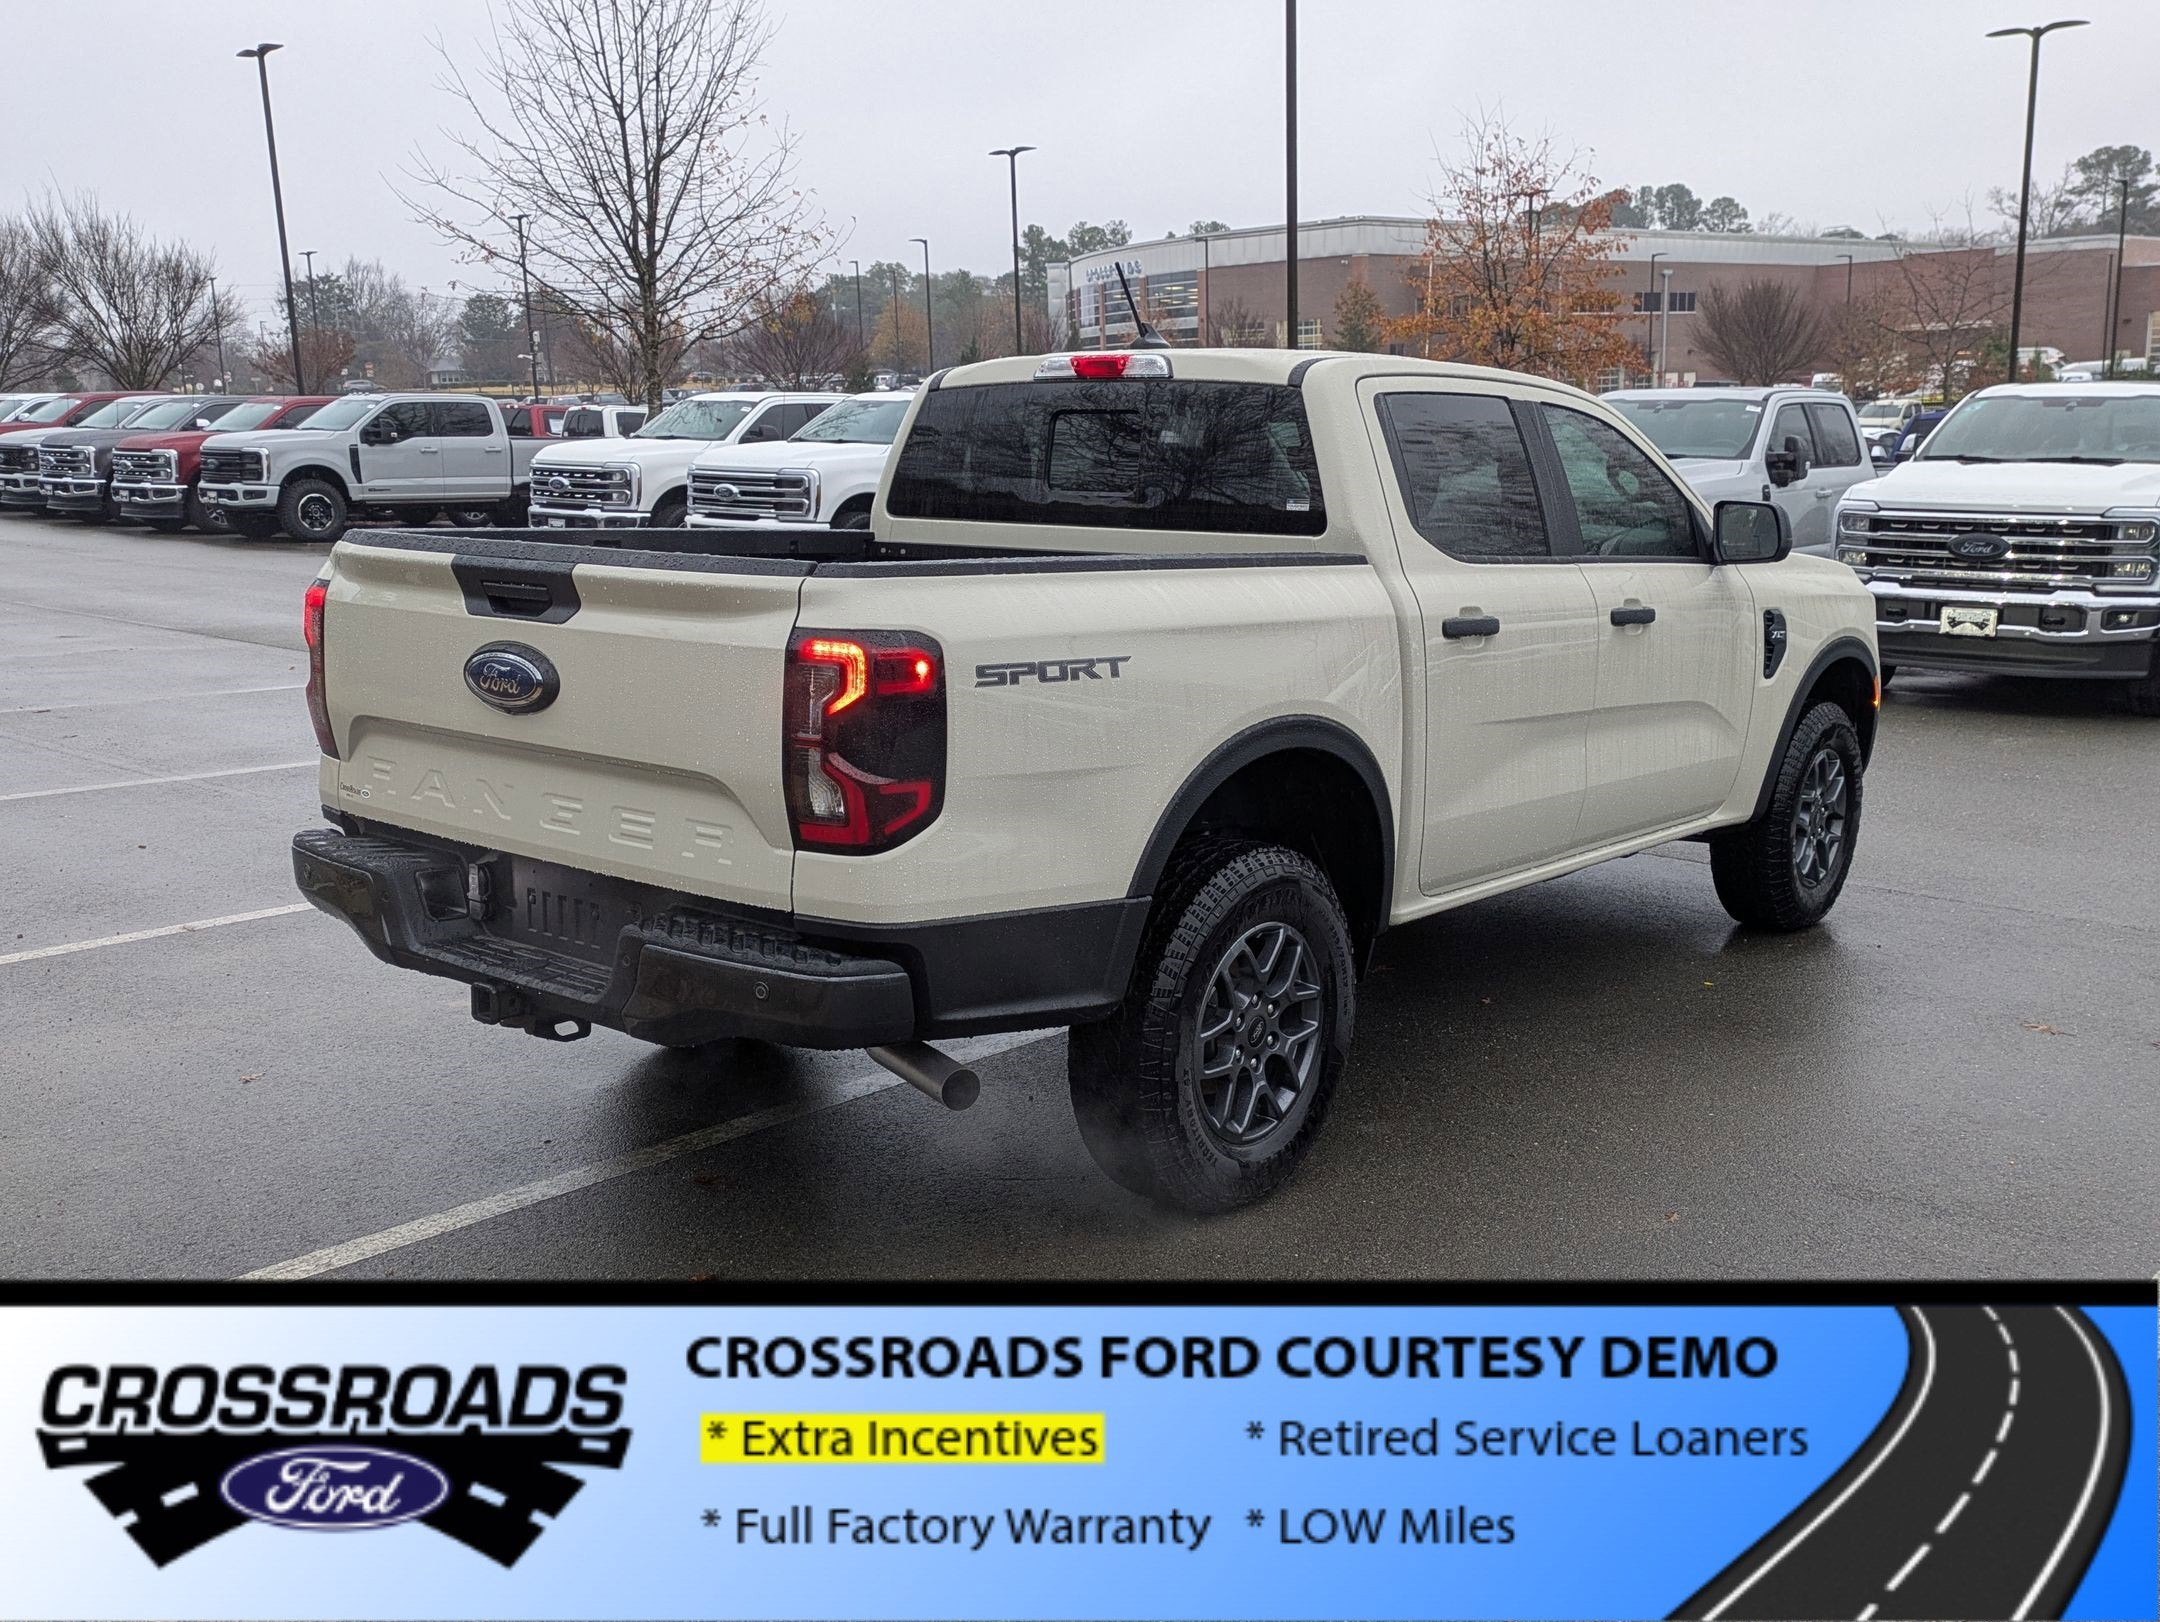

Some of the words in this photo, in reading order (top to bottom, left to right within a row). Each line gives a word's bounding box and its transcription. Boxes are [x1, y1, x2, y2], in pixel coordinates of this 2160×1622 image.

[1960, 542, 1994, 554] Ford
[479, 662, 521, 695] Ford
[974, 655, 1132, 688] SPORT
[364, 755, 734, 866] RANGER
